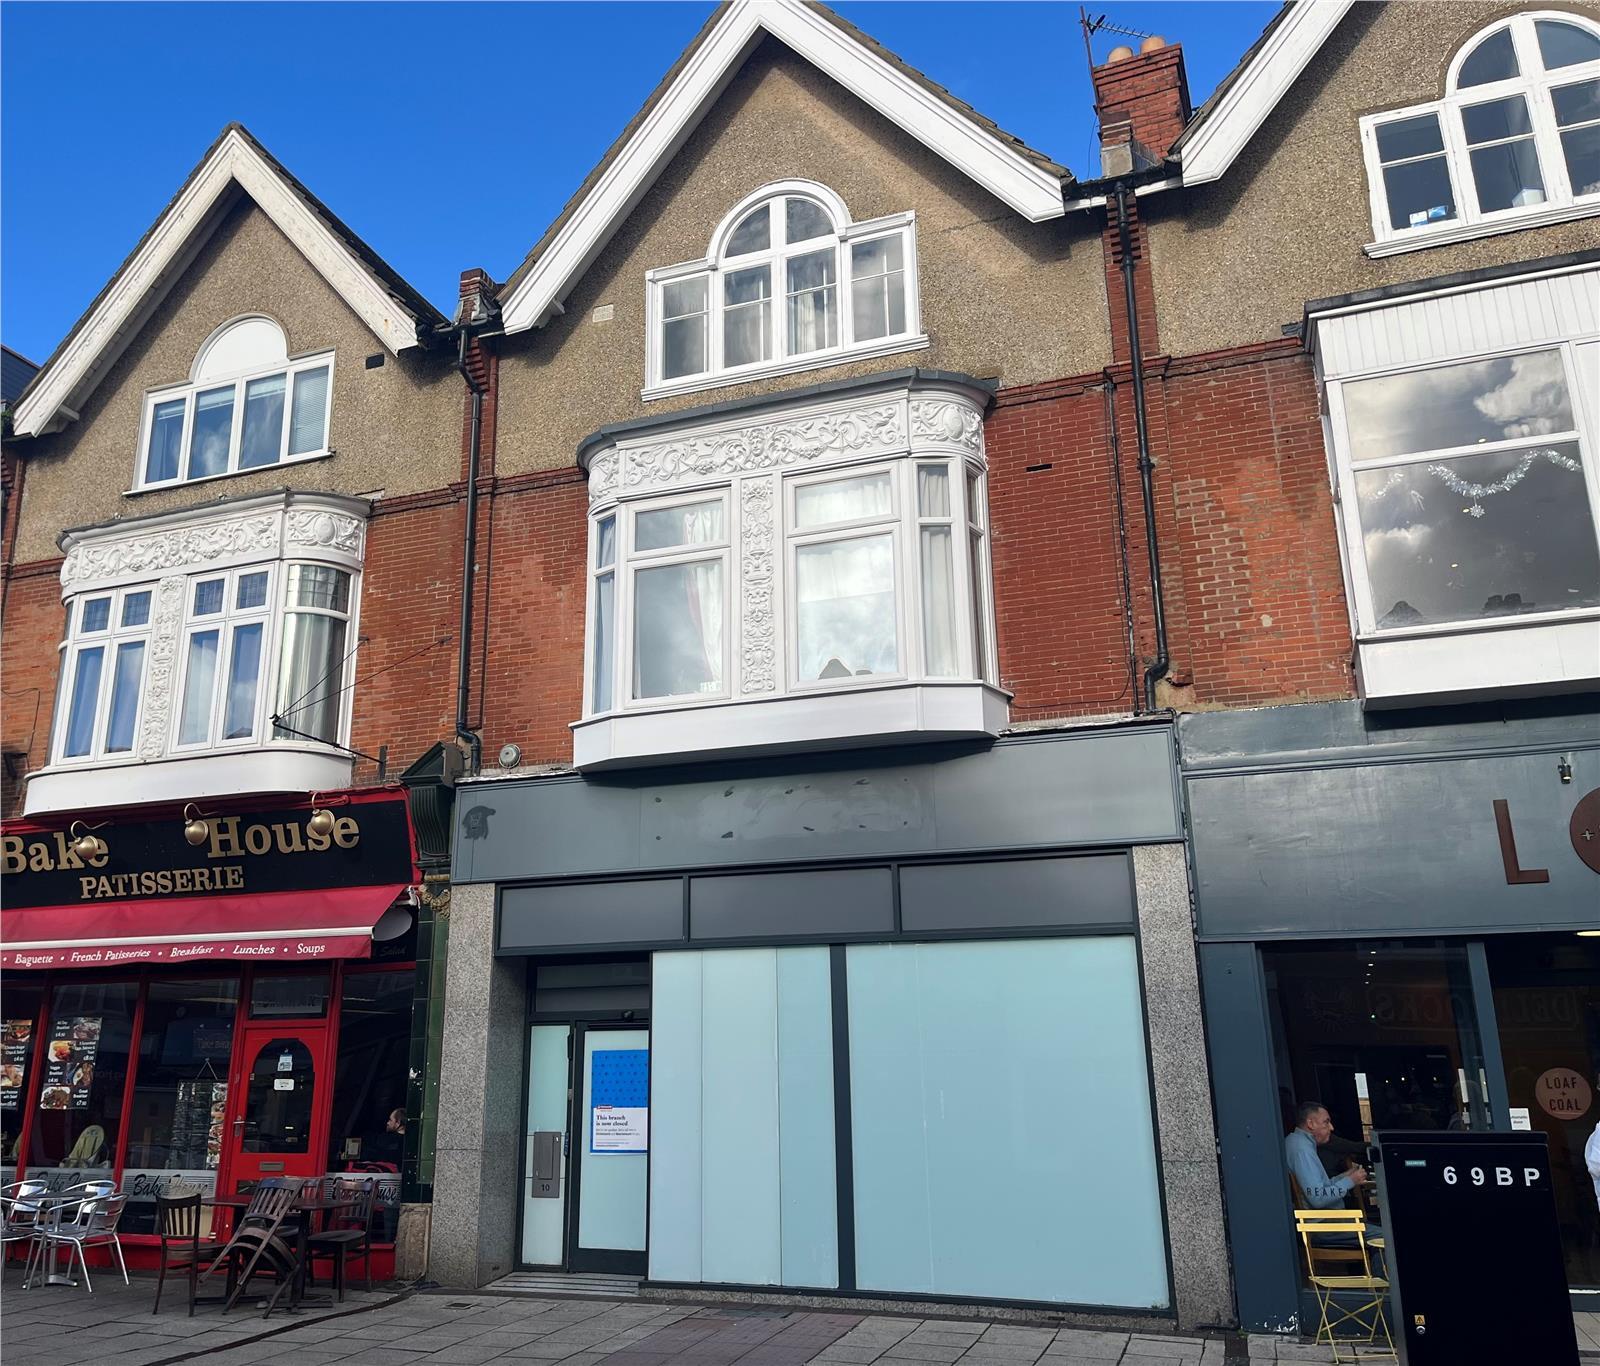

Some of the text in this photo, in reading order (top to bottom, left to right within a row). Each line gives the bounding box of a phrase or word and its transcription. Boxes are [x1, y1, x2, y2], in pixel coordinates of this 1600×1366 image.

[1, 815, 360, 874] Bake House
[79, 865, 246, 900] PATISSERIE
[14, 942, 326, 966] Baguette French Patisseries Breakfast Lunches Soups
[1545, 1077, 1577, 1090] LOAF
[1549, 1098, 1582, 1111] COAL
[133, 1173, 208, 1196] Bake House
[541, 1184, 550, 1192] 10
